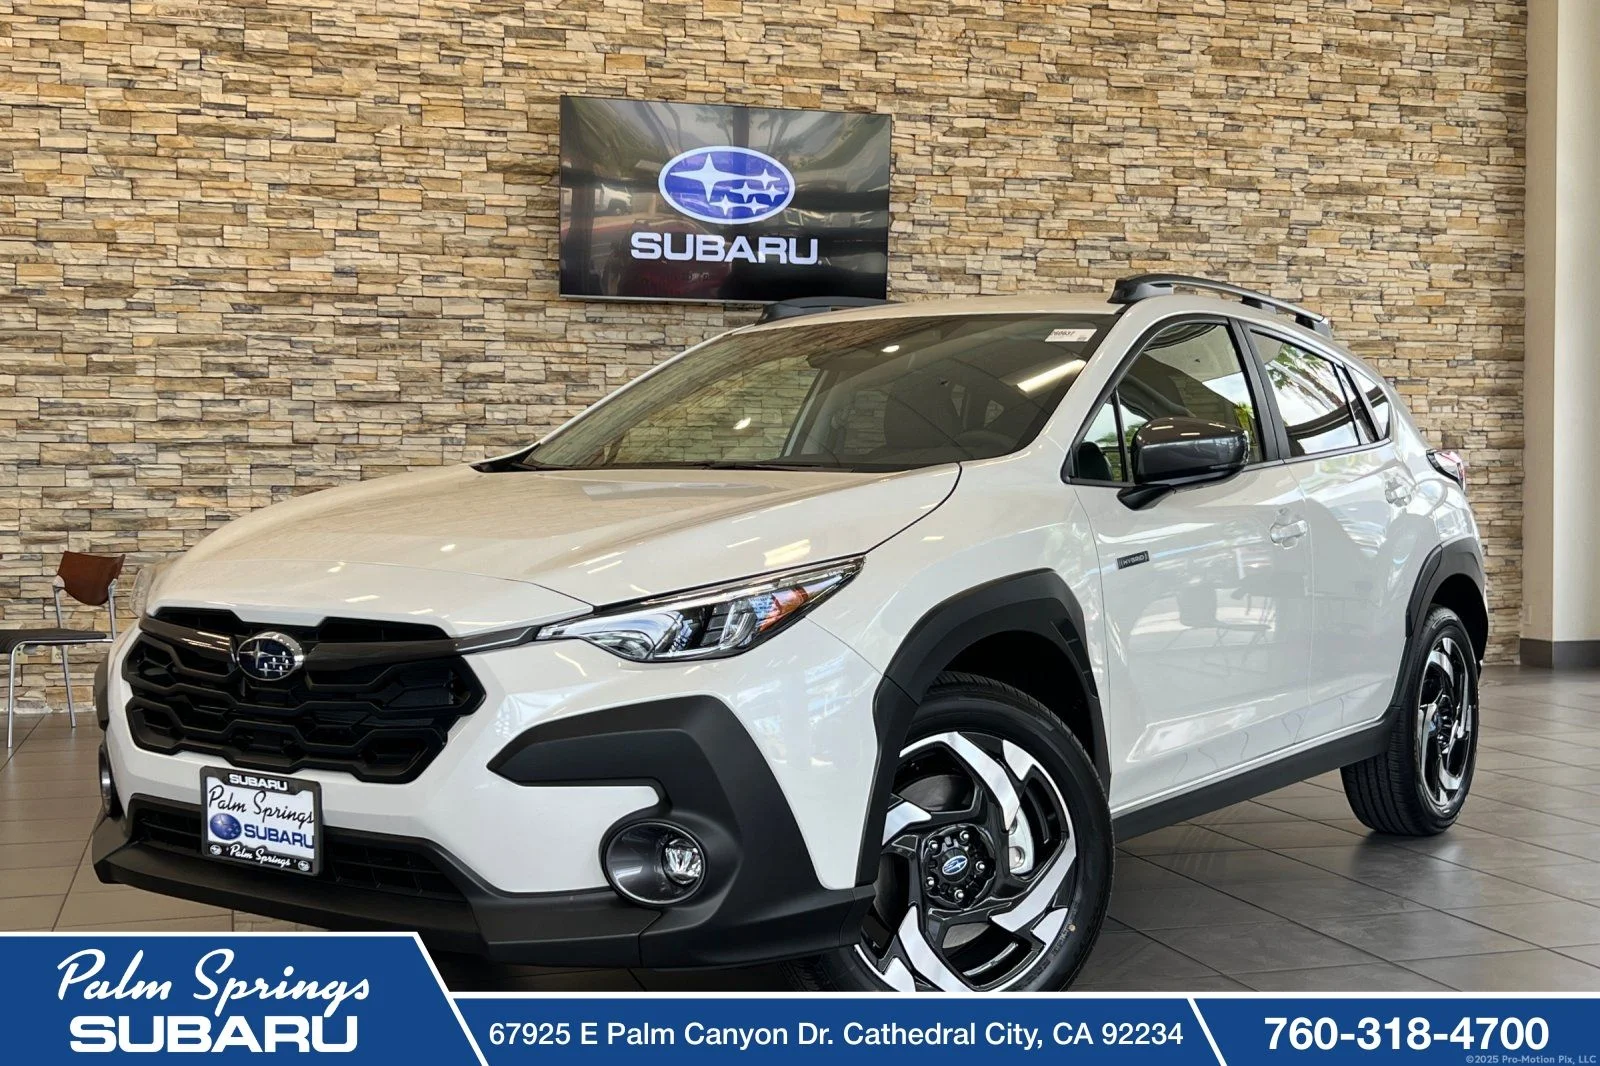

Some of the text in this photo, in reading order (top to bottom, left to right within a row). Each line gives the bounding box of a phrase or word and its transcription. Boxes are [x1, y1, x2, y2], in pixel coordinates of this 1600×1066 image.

[630, 231, 819, 265] SUBARU
[229, 773, 288, 791] SUBARU
[208, 784, 315, 830] Palm Springs
[244, 823, 315, 849] SUBARU
[229, 843, 291, 868] Palm Springs
